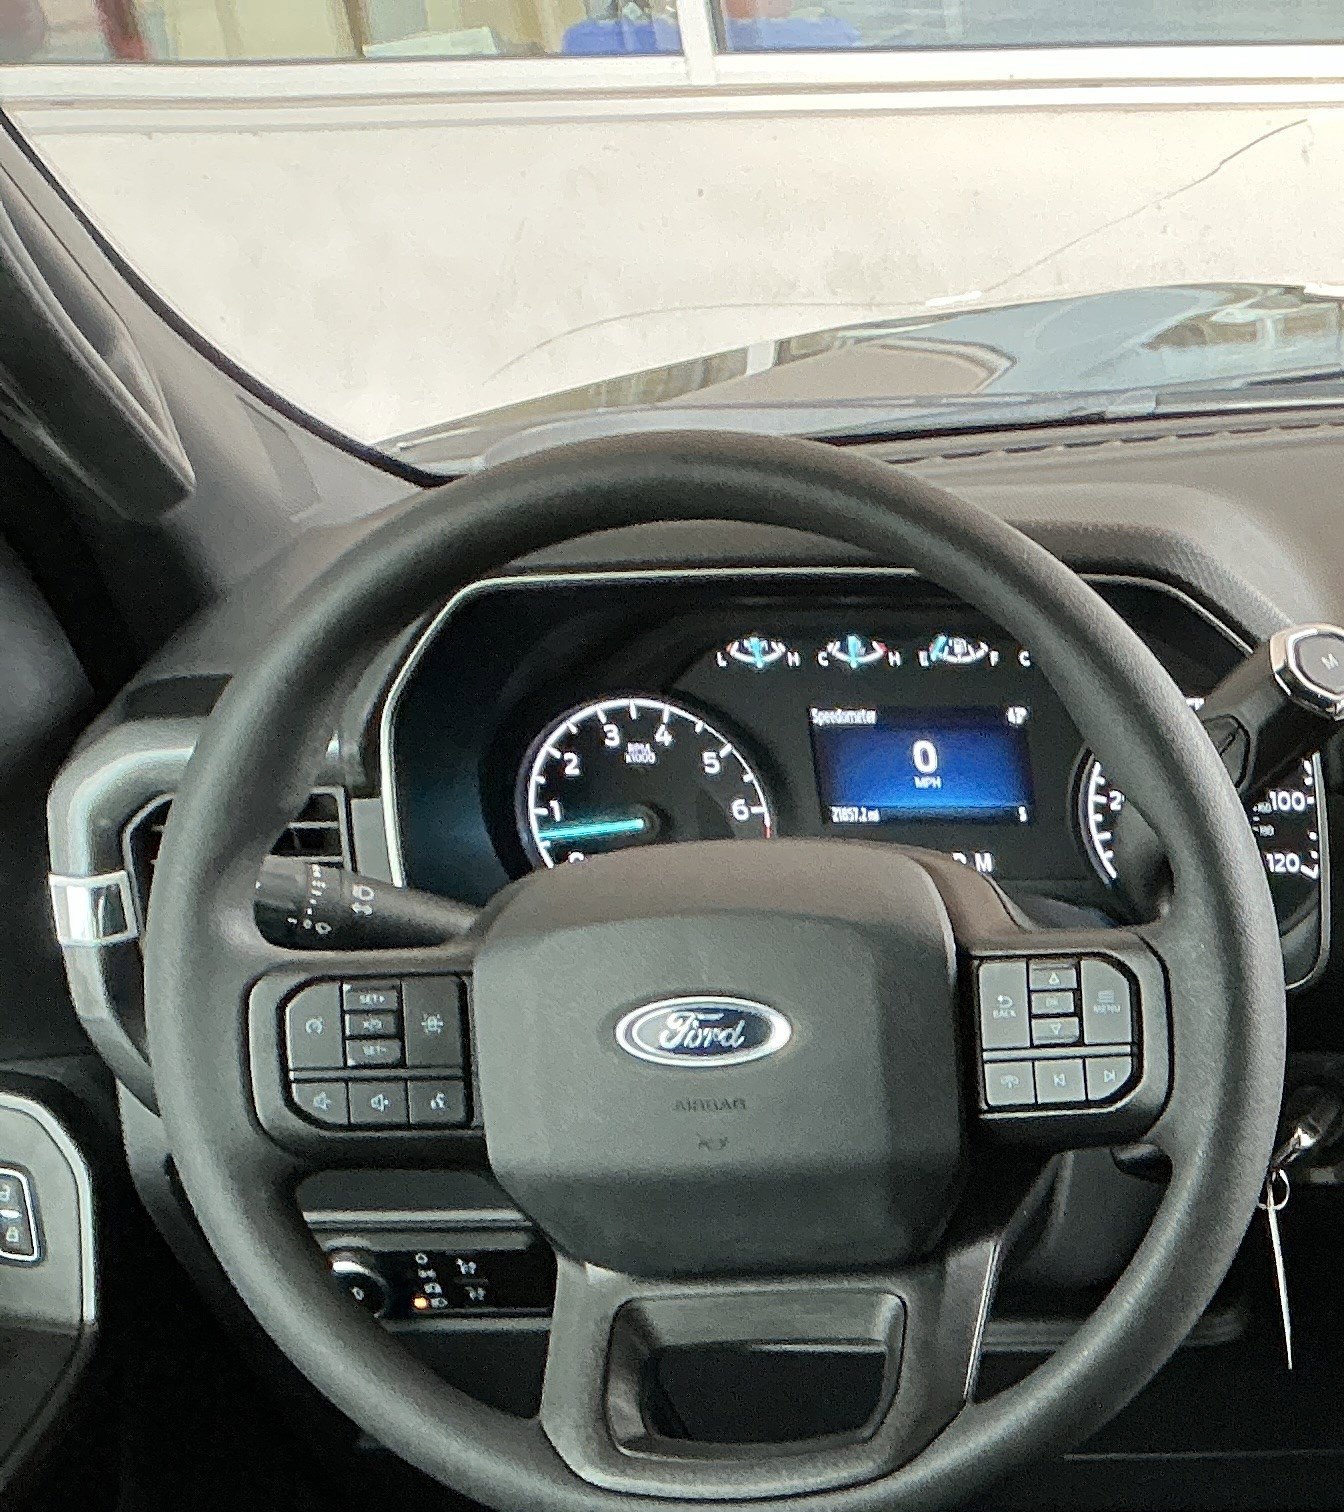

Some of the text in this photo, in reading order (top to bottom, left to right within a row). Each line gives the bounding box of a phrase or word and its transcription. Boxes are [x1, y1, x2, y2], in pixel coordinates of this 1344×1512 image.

[787, 651, 800, 667] H
[818, 651, 829, 667] C
[888, 651, 900, 667] H
[989, 651, 999, 666] F
[1018, 651, 1030, 667] C
[602, 723, 620, 747] 3
[655, 724, 673, 746] 4
[563, 752, 580, 776] 2
[702, 751, 721, 774] 5
[912, 739, 938, 774] 0
[913, 775, 942, 789] MPH
[549, 799, 561, 822] 1
[731, 798, 749, 822] 6
[1269, 790, 1305, 811] 100
[974, 851, 993, 873] M
[1266, 852, 1300, 873] 120
[658, 1010, 746, 1049] Ford
